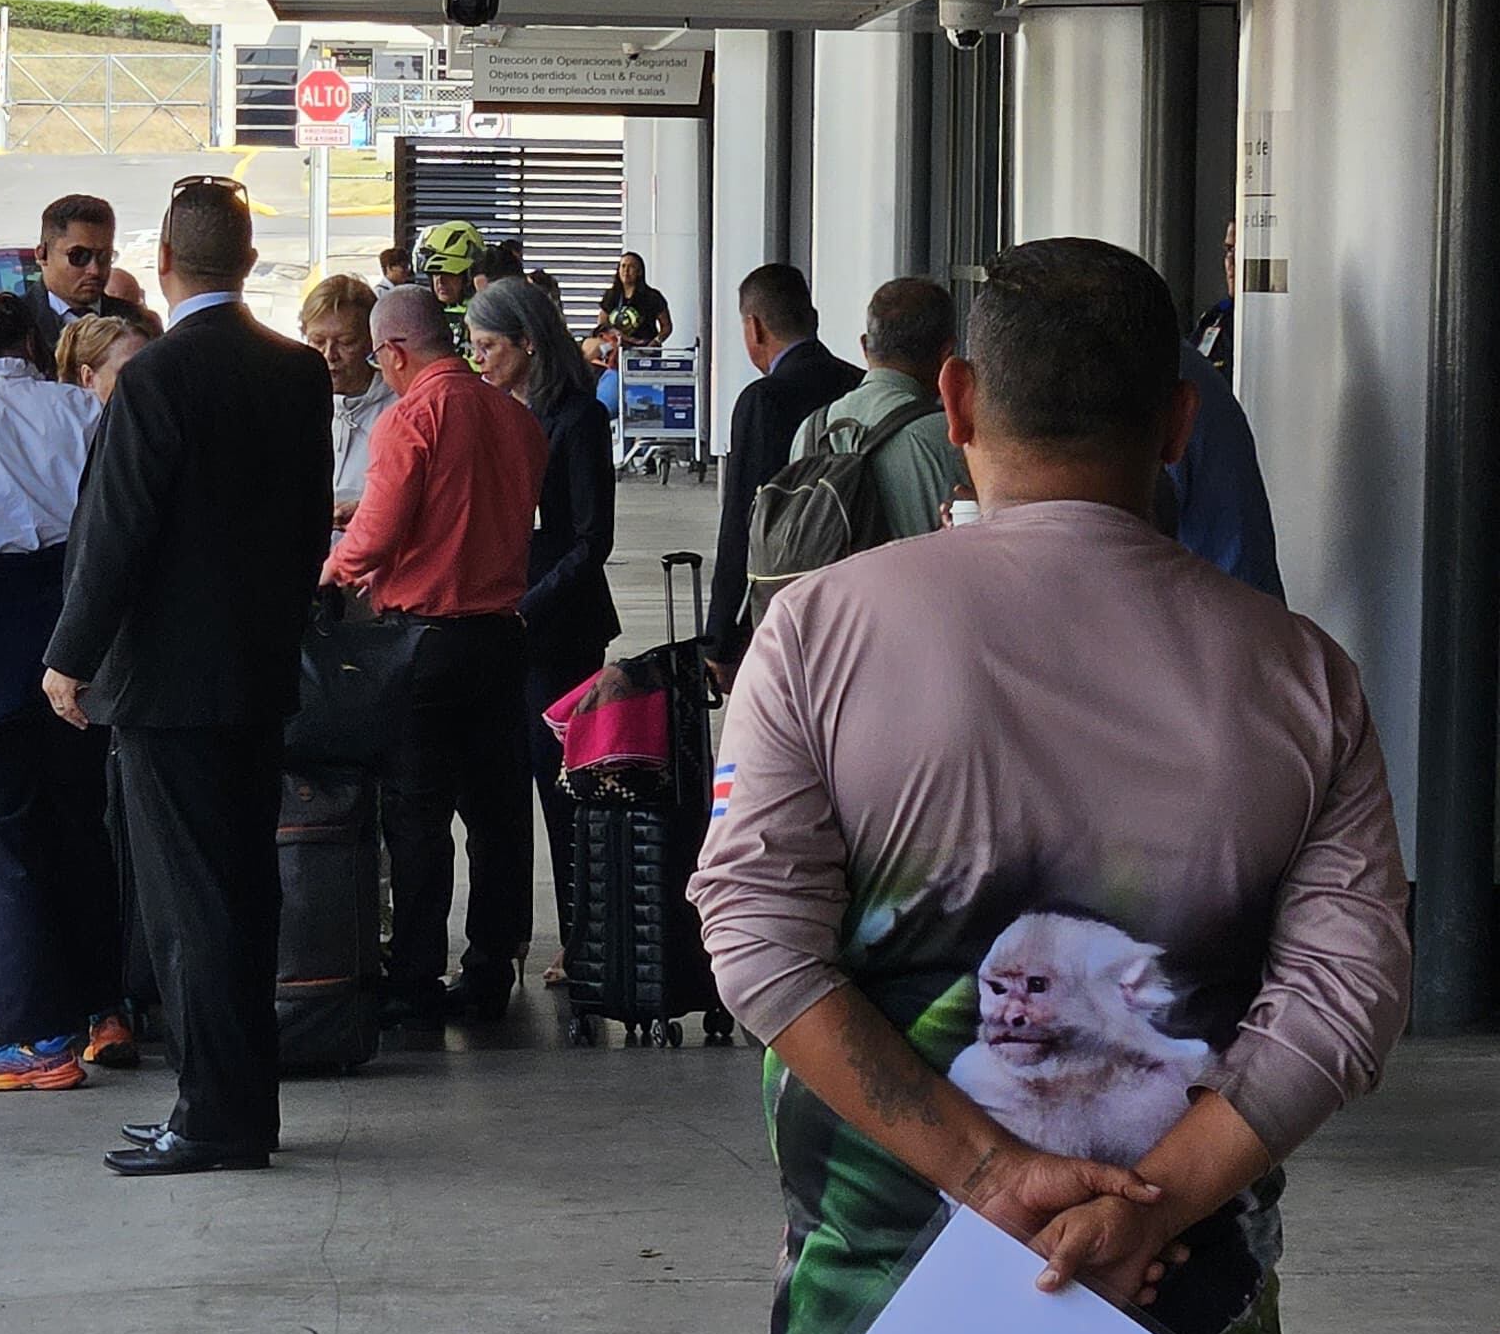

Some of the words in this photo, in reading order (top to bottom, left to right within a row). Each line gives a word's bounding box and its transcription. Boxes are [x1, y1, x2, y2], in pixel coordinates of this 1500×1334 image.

[489, 55, 538, 65] Dirección
[541, 56, 553, 65] de
[557, 56, 622, 67] Operaciones
[635, 58, 688, 69] Seguridad
[489, 70, 529, 81] Objetos
[532, 71, 577, 81] perdidos
[593, 72, 615, 81] Lost
[618, 72, 626, 81] &
[629, 72, 662, 81] Found
[301, 85, 347, 107] ALTO
[489, 85, 529, 96] Ingreso
[532, 85, 545, 94] de
[548, 85, 607, 96] empleados
[610, 87, 634, 95] nivel
[638, 87, 666, 96] salas
